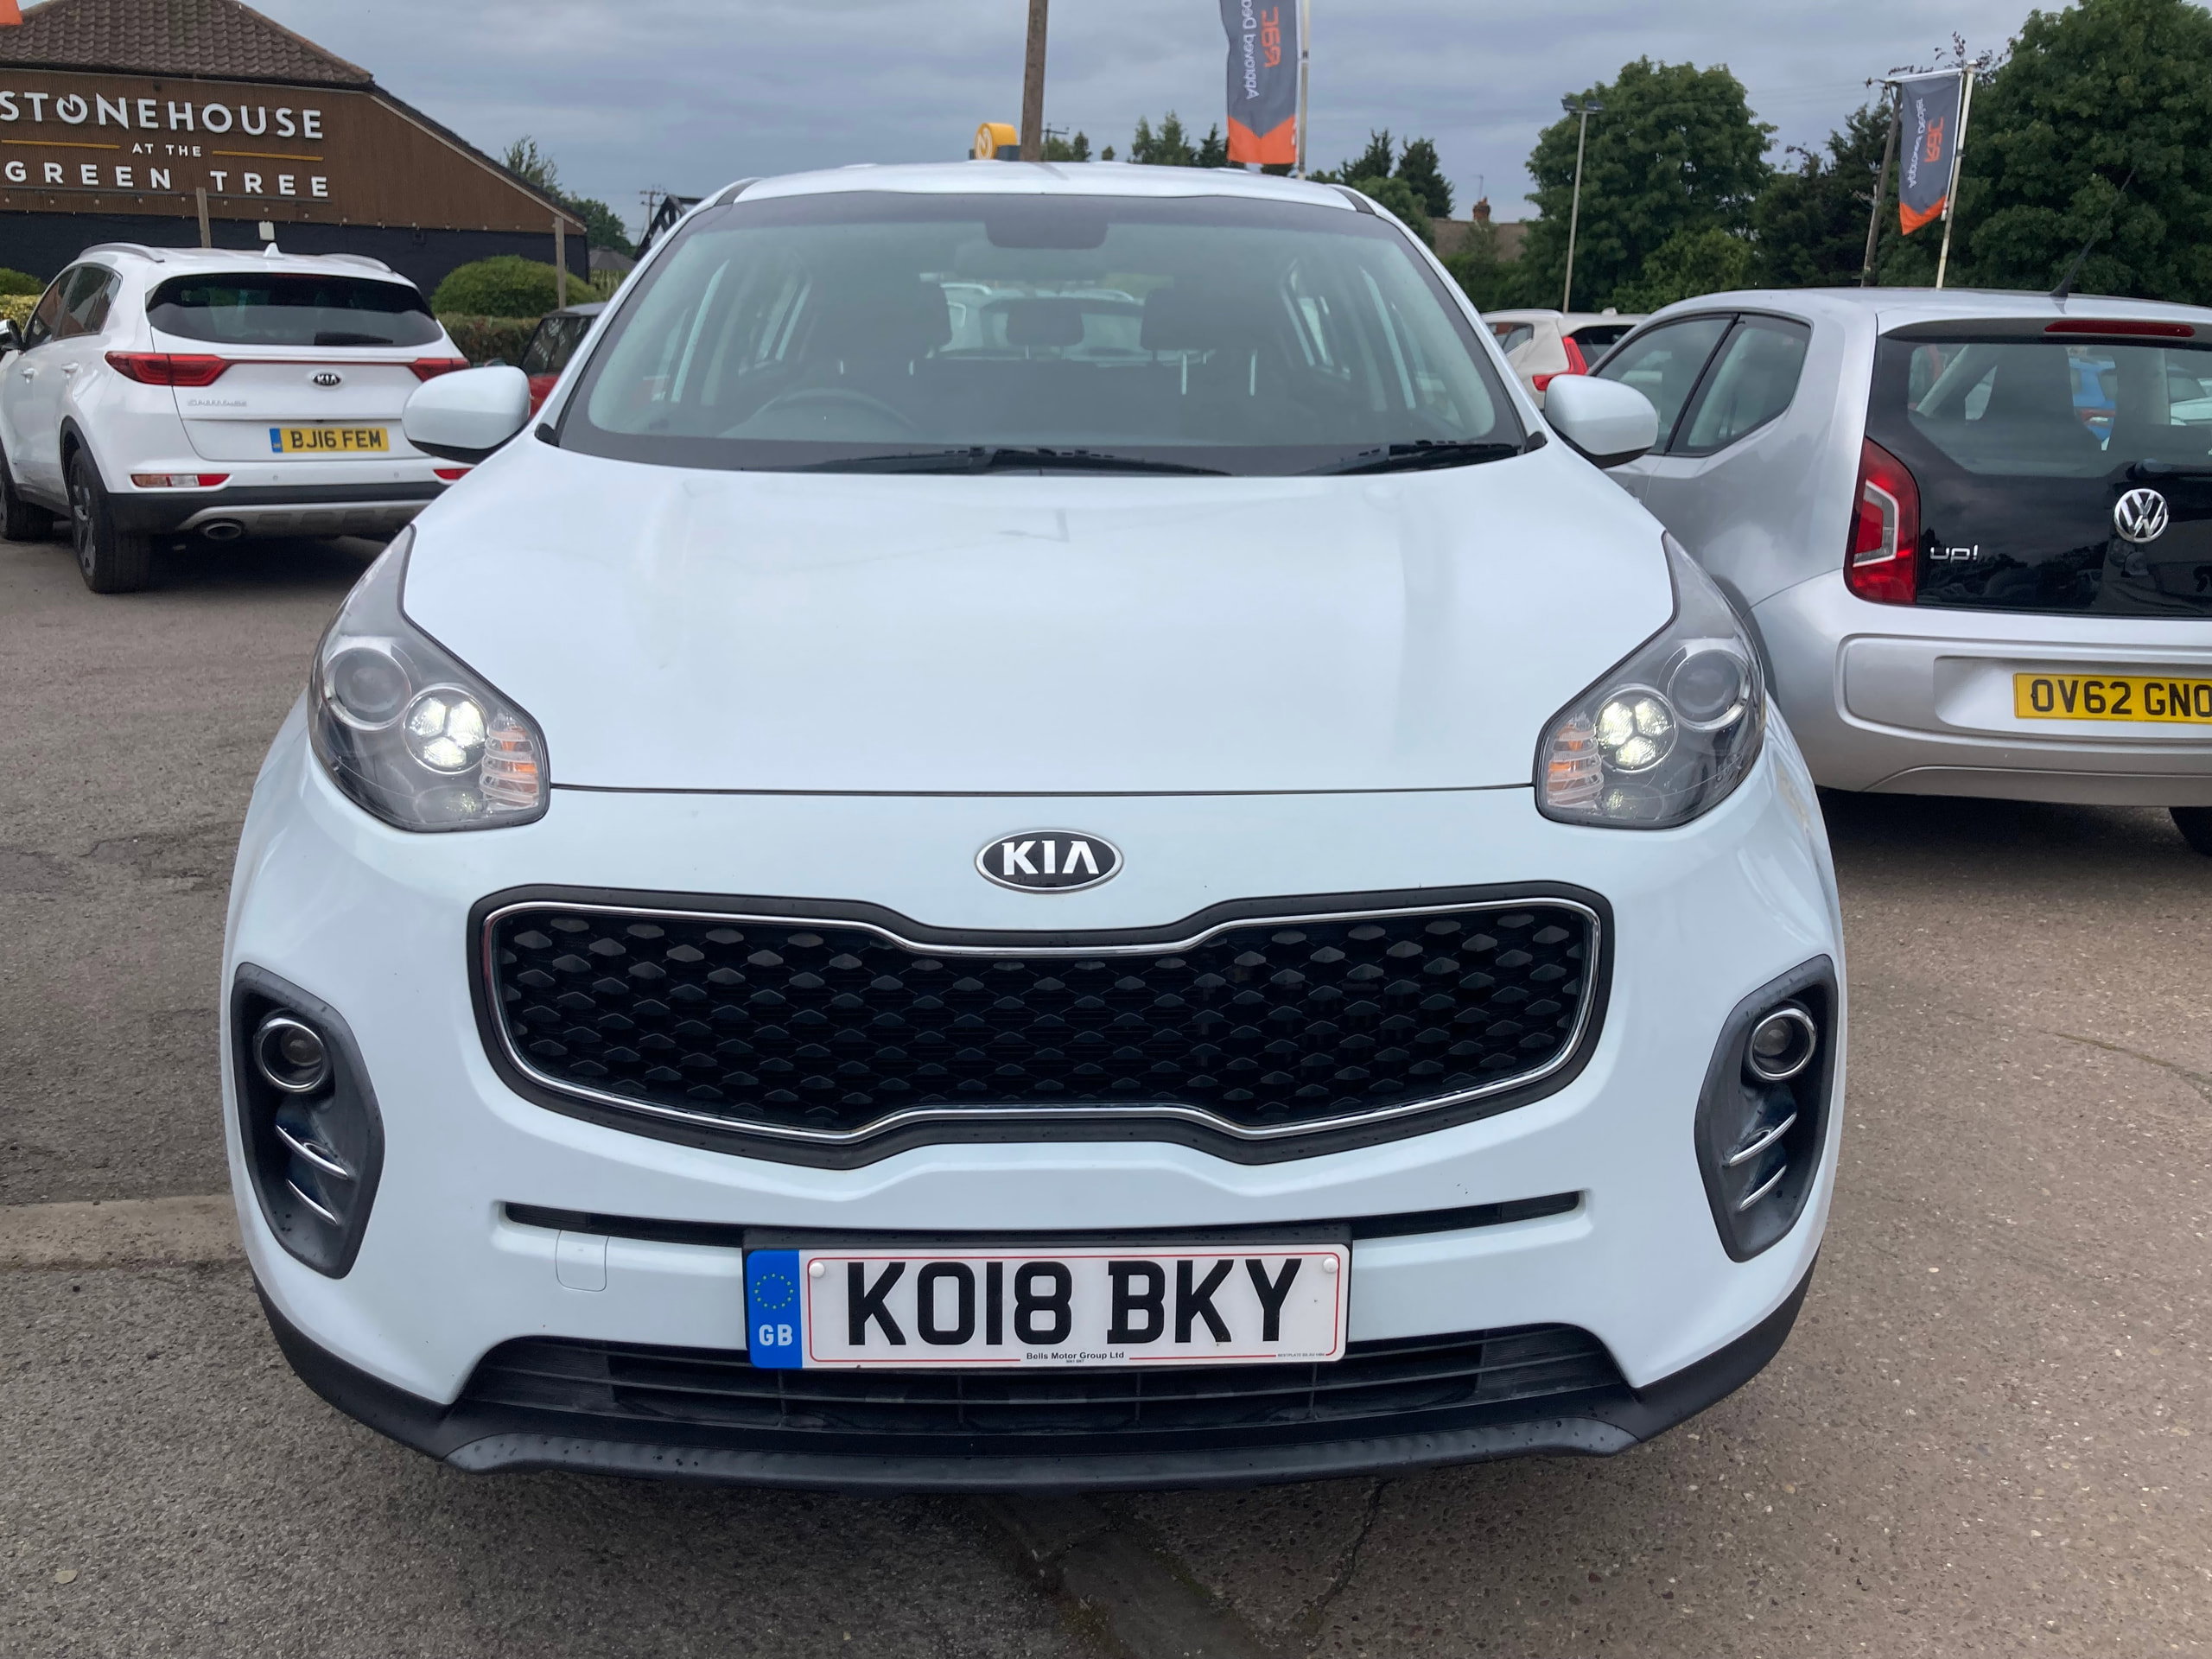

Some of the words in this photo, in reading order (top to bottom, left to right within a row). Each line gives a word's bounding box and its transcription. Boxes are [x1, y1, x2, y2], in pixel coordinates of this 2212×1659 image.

[0, 91, 323, 139] STONEHOUSE
[132, 143, 154, 155] AT
[165, 144, 201, 157] THE
[5, 161, 171, 190] GREEN
[210, 171, 328, 197] TREE
[315, 373, 338, 385] KIA
[290, 430, 337, 448] BJ16
[343, 430, 382, 448] FEM
[1929, 544, 1979, 563] up!
[2031, 678, 2133, 715] OV62
[2144, 682, 2212, 718] GNO
[1001, 840, 1100, 875] KIA
[848, 1261, 1073, 1346] KO18
[1107, 1258, 1303, 1344] BKY
[759, 1324, 793, 1347] GB
[1079, 1351, 1108, 1361] Group
[1109, 1351, 1124, 1359] Ltd
